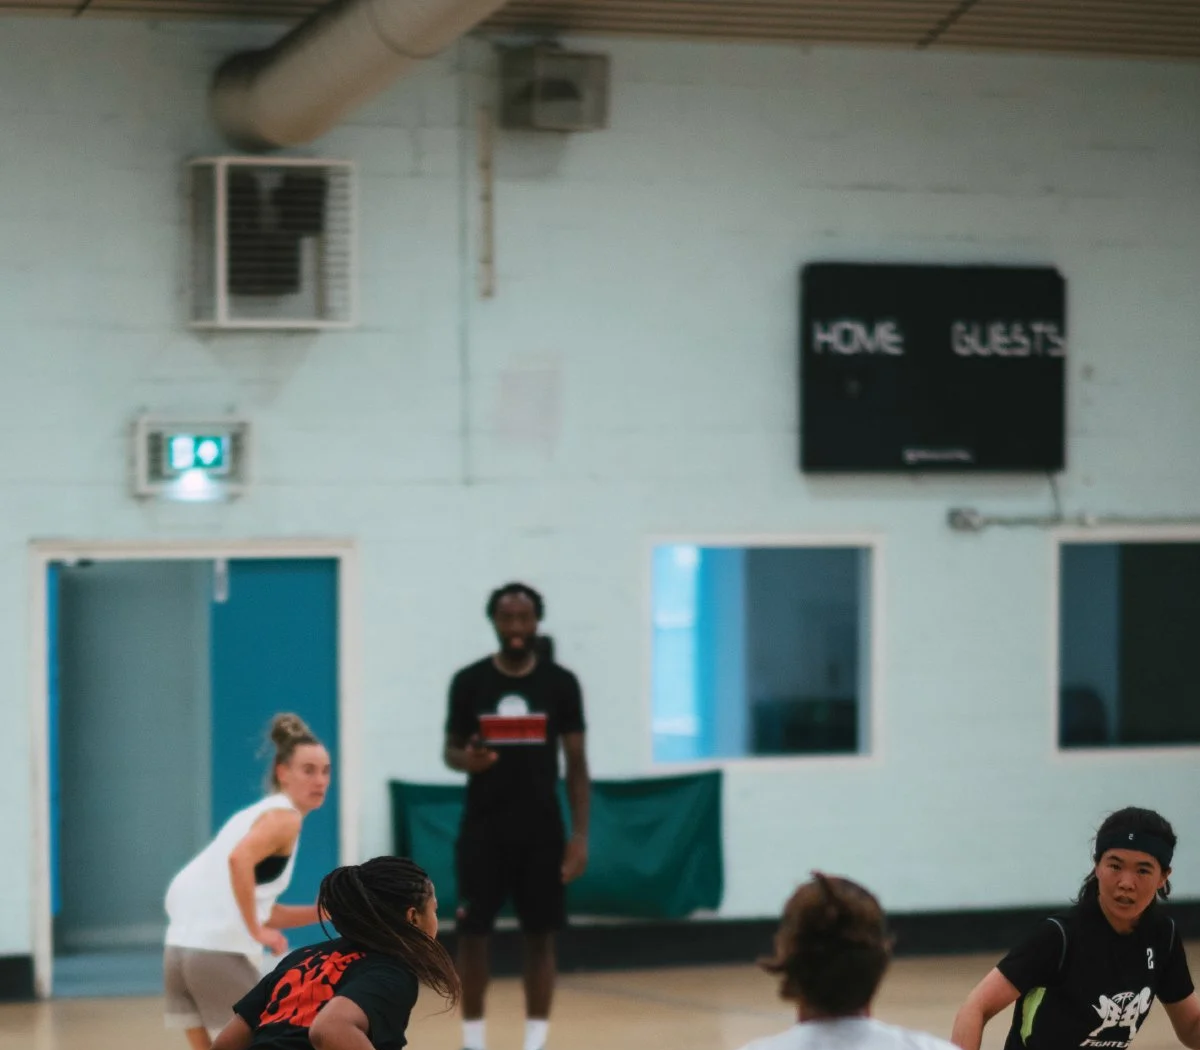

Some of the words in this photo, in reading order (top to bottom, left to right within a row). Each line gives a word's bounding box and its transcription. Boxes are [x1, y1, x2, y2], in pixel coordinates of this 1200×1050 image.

[812, 320, 904, 355] HOME
[952, 321, 1067, 357] GUESTS
[1146, 947, 1155, 969] 2
